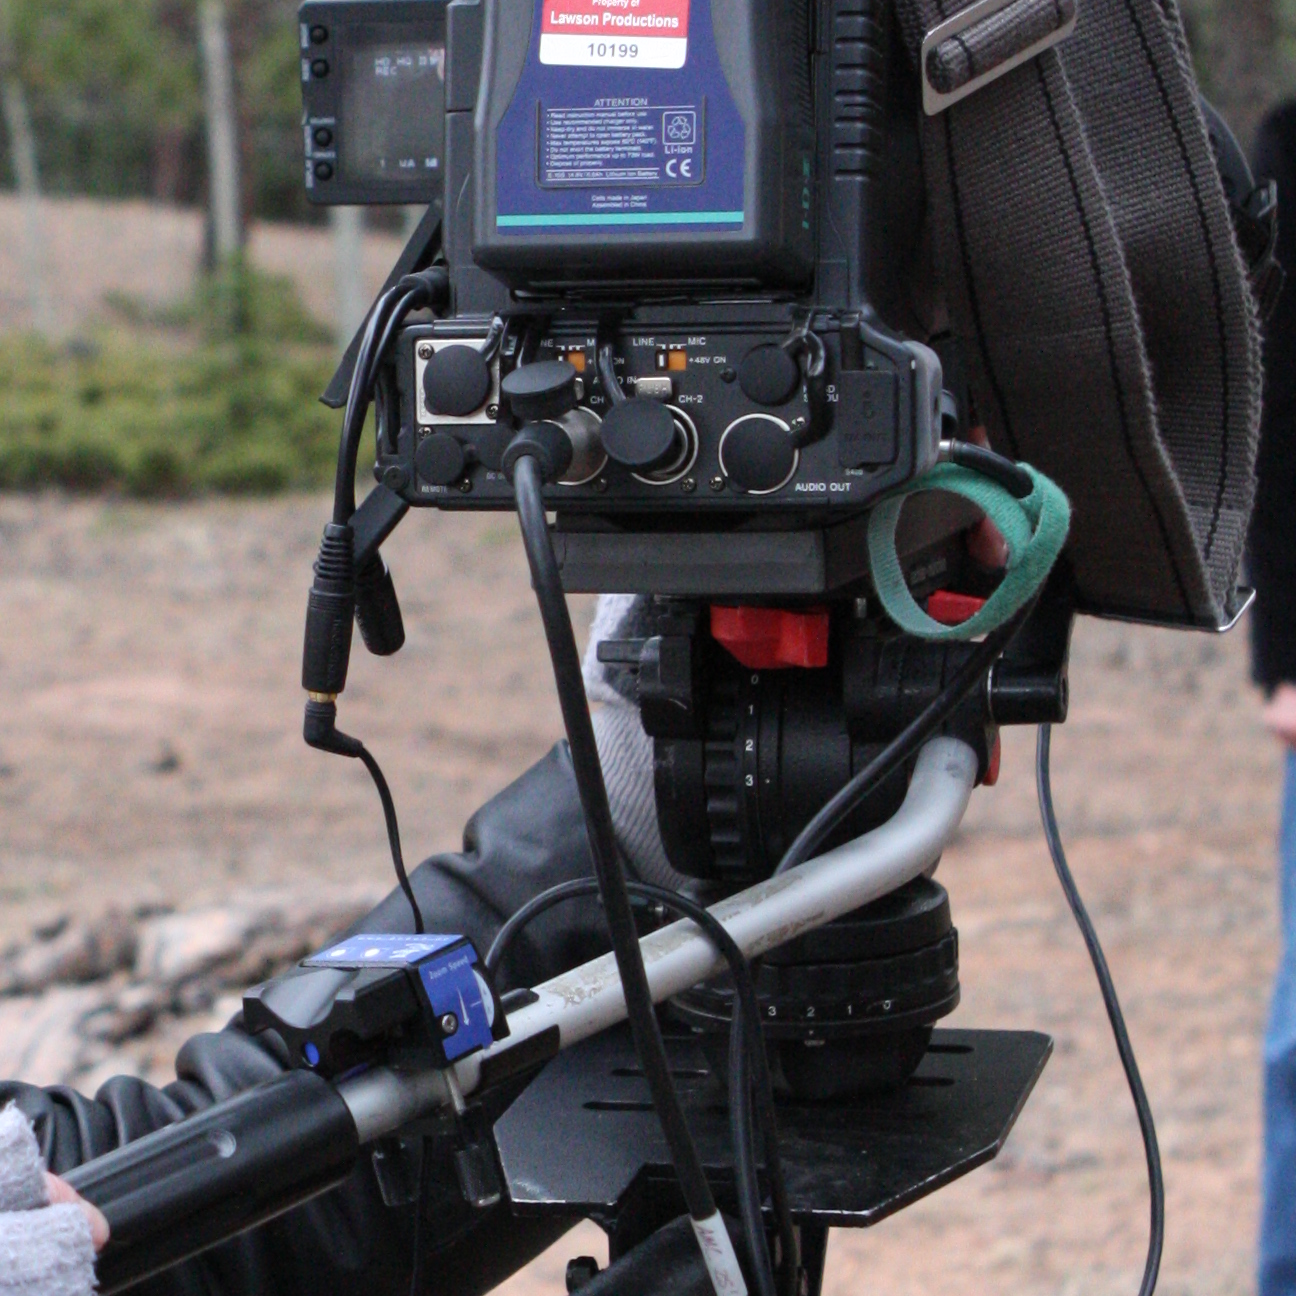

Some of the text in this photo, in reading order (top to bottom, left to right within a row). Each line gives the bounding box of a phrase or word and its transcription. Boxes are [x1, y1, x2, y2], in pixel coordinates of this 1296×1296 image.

[550, 10, 680, 29] Lawson Productions
[587, 43, 639, 58] 10199
[594, 98, 648, 107] ATTENTION
[632, 338, 655, 347] LINE
[687, 337, 706, 346] MIC
[678, 395, 704, 404] CH-2
[795, 482, 851, 492] AUDIO OUT
[748, 704, 754, 715] 1
[745, 739, 754, 752] 2
[745, 774, 754, 787] 3
[767, 1005, 777, 1016] 3
[806, 1005, 815, 1017] 2
[847, 1004, 852, 1015] 1
